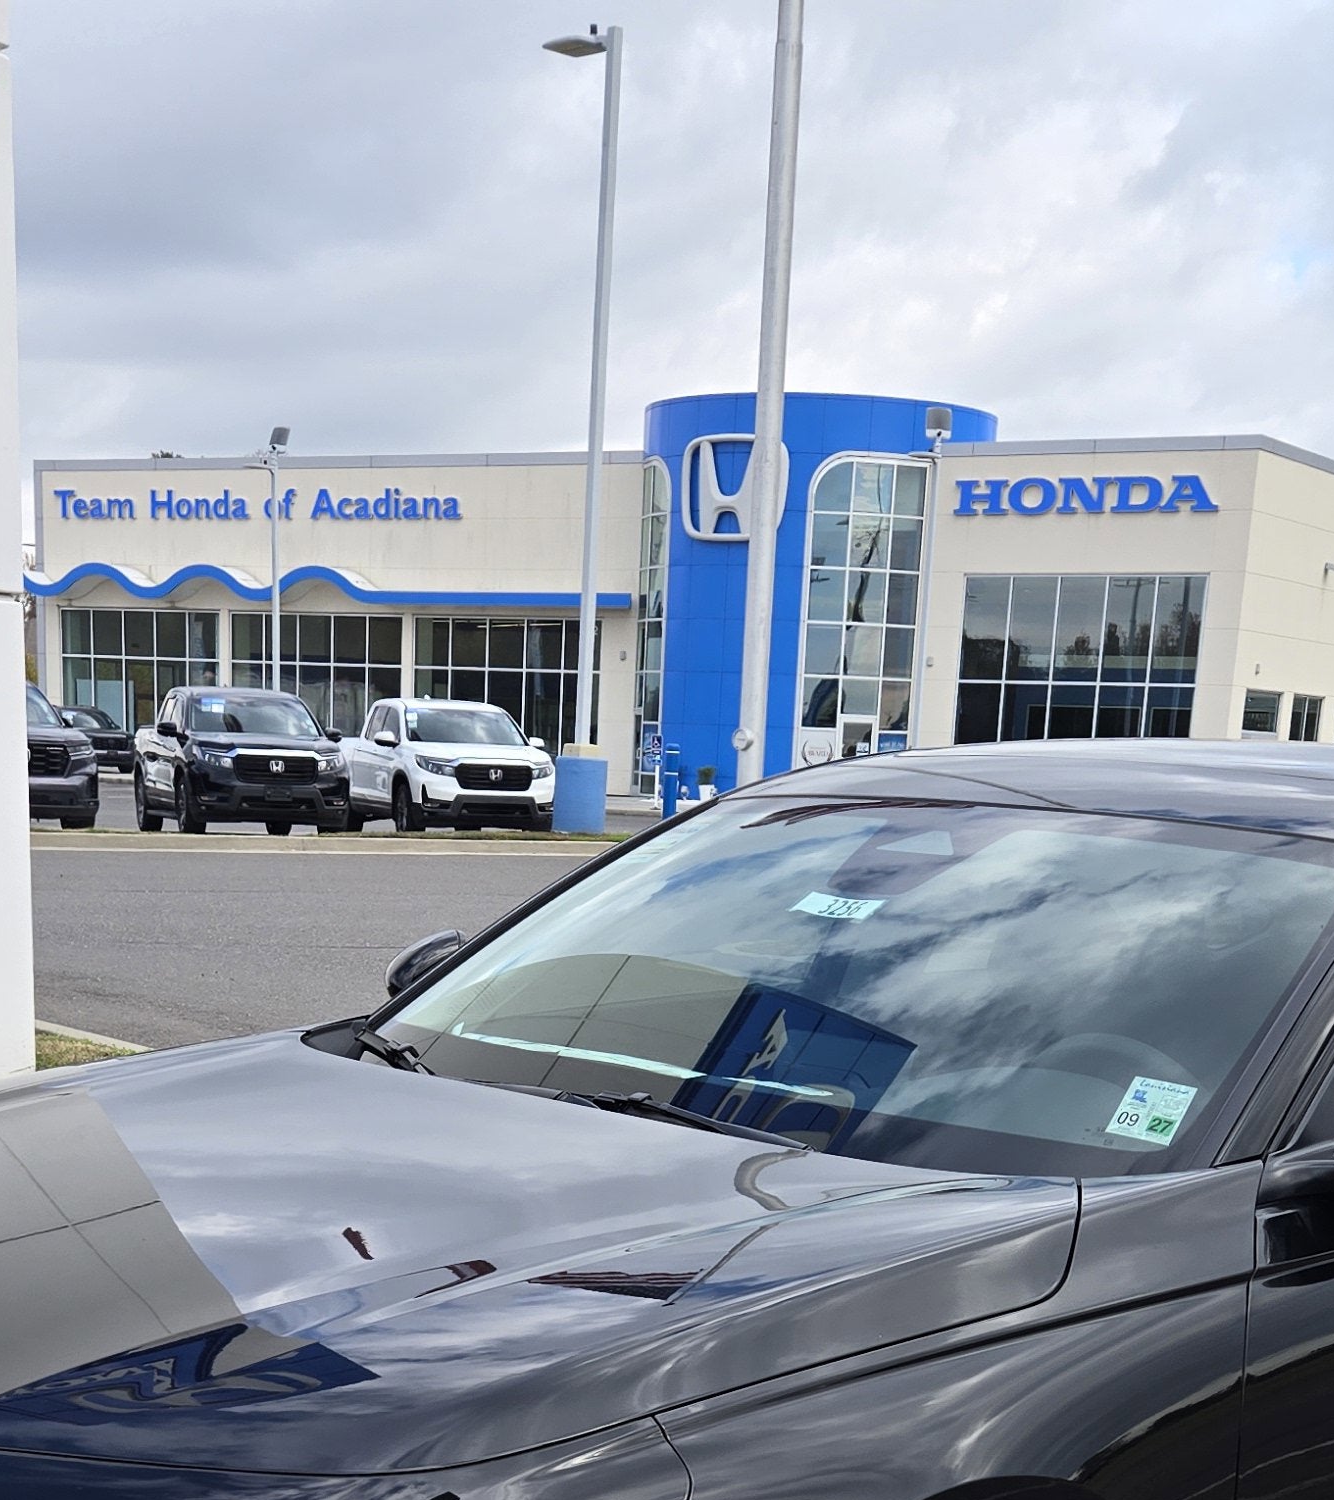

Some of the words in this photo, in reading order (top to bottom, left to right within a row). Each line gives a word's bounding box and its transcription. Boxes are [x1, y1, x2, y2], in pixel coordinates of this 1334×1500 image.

[54, 490, 135, 519] Team
[150, 489, 250, 519] Honda
[311, 488, 462, 519] Acadiana
[954, 475, 1218, 516] HONDA
[818, 899, 869, 916] 3256
[1117, 1111, 1140, 1127] 09
[1146, 1117, 1174, 1133] 27
